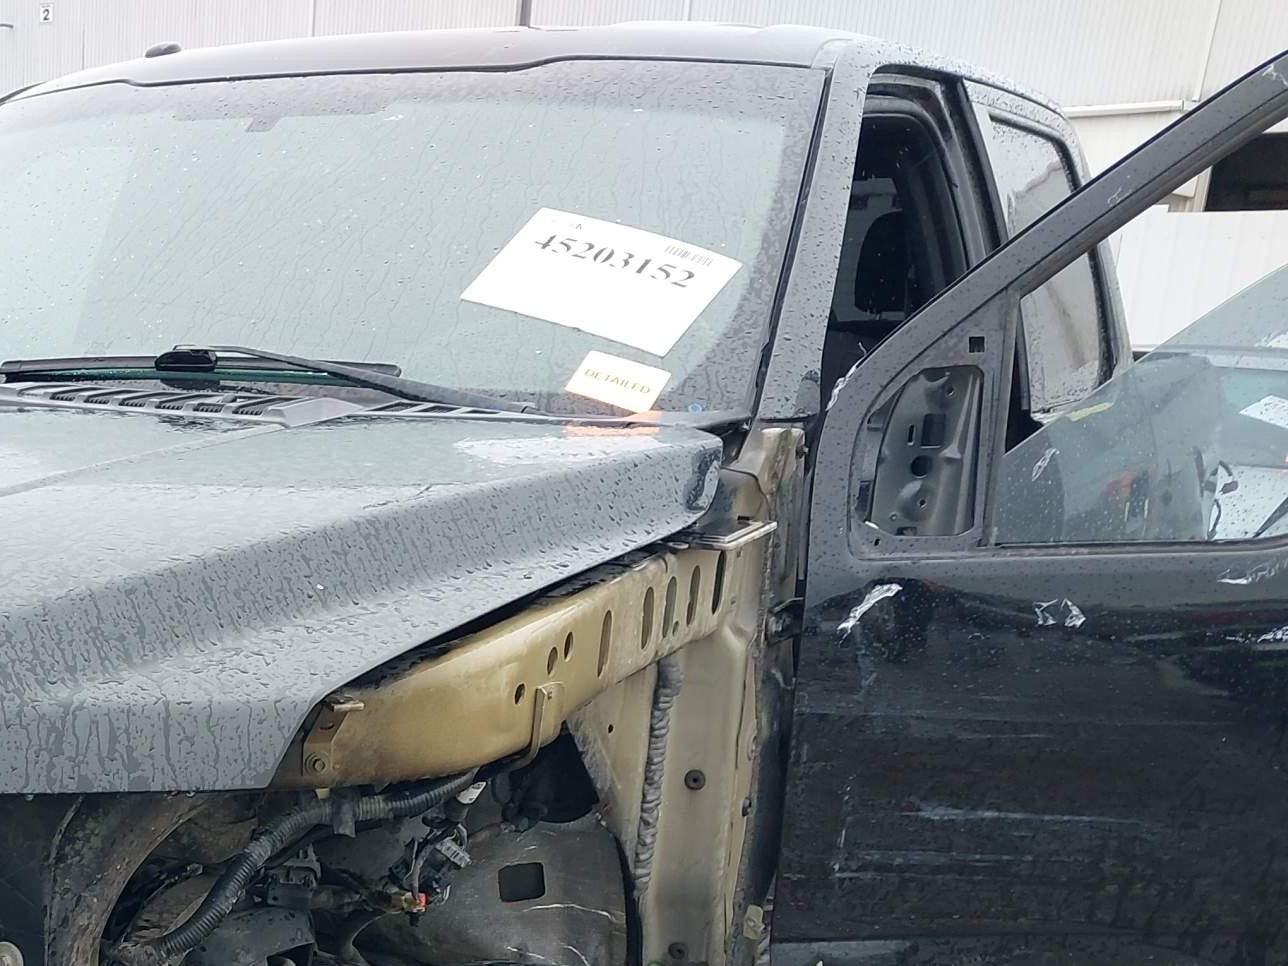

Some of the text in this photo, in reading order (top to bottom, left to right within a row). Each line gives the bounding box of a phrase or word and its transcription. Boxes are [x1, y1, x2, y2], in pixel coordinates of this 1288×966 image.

[42, 8, 50, 21] 2
[534, 233, 696, 288] 45203152
[583, 368, 651, 393] DETAILED
